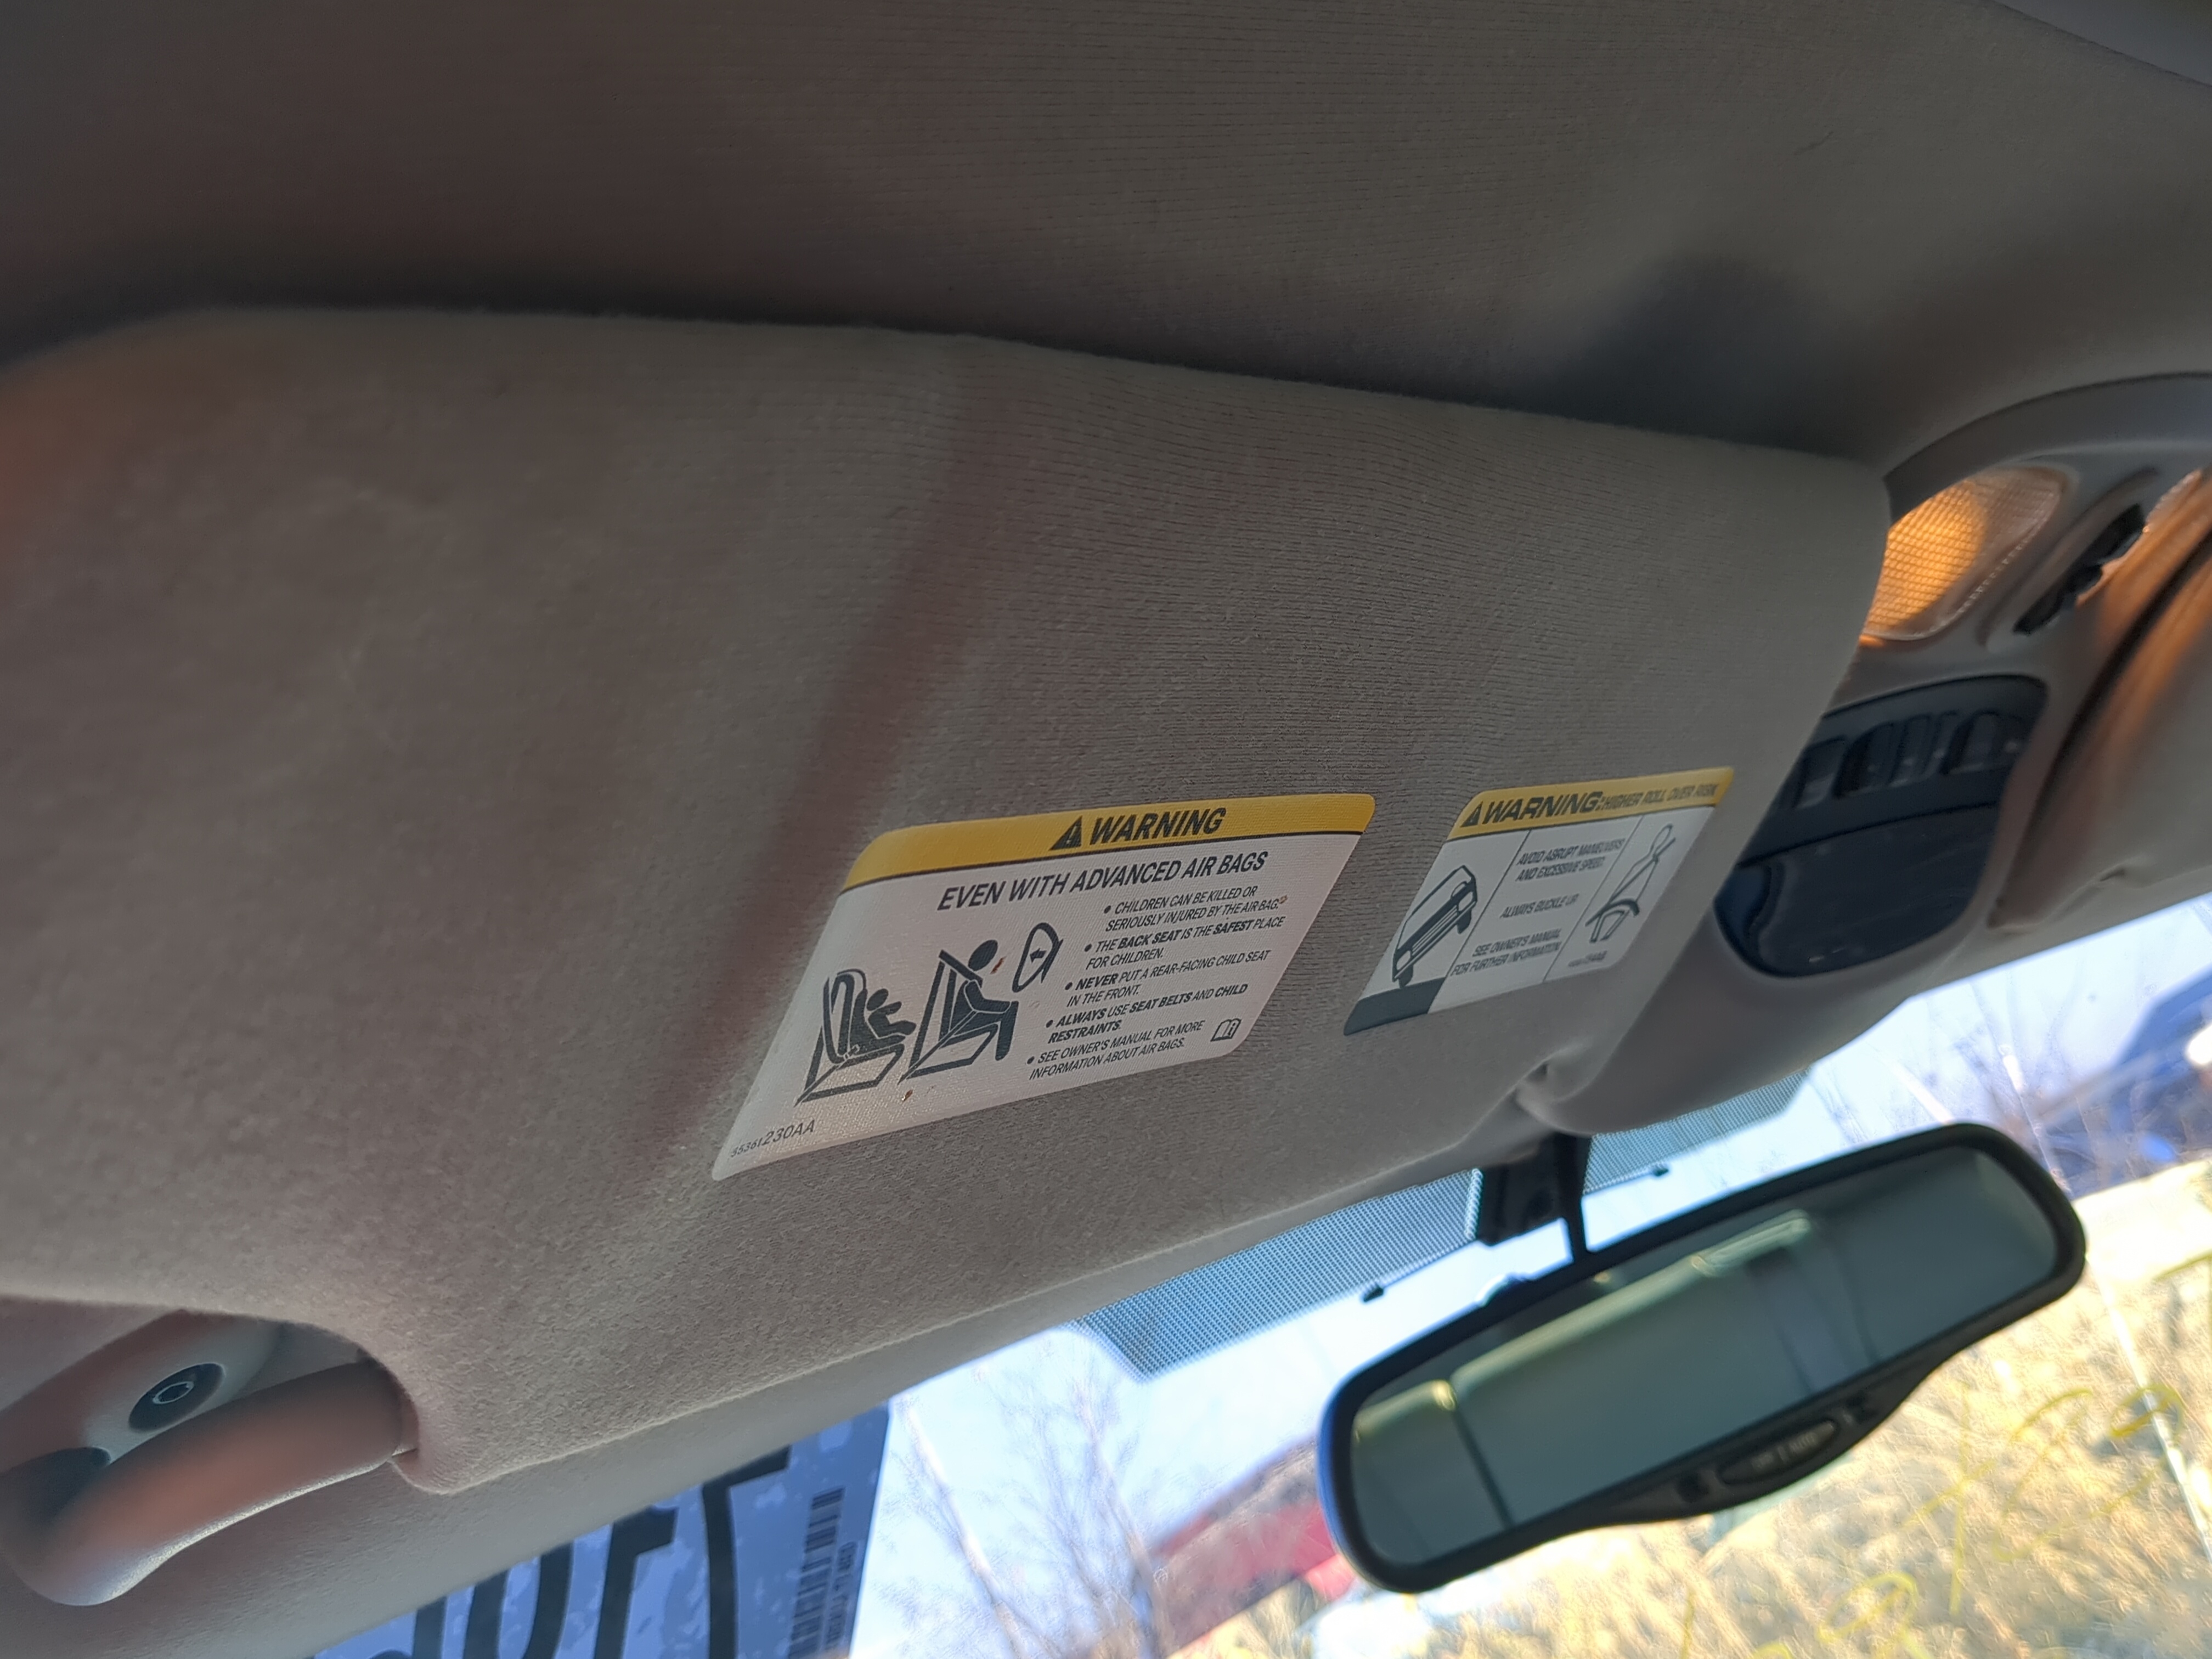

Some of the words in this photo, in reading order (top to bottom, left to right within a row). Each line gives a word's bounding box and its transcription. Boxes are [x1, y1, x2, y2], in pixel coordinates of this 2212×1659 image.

[1482, 791, 1603, 825] WARNING:
[1602, 792, 1644, 810] HIGHER
[1090, 808, 1226, 845] WARNING
[1516, 851, 1545, 865] AVOID
[1543, 845, 1579, 862] ABRUPT
[936, 882, 1006, 911] EVEN
[1008, 873, 1070, 901] WITH
[1070, 860, 1182, 893] ADVANCED
[1181, 856, 1216, 878] AIR
[1216, 850, 1268, 874] BAGS
[1515, 870, 1536, 882] AND
[1105, 912, 1165, 932] SERIOUSLY
[1164, 907, 1207, 924] INJURED
[1207, 906, 1221, 917] BY
[1221, 903, 1242, 915] THE
[1240, 901, 1260, 913] AIR
[1259, 899, 1279, 911] BAG.
[1114, 895, 1170, 915] CHILDREN
[1170, 893, 1191, 907] CAN
[1193, 891, 1207, 904] BE
[1206, 888, 1242, 902] KILLED
[1242, 885, 1258, 898] OR
[1499, 902, 1535, 918] ALWAYS
[1534, 896, 1565, 912] BUCKLE
[1096, 939, 1119, 953] THE
[1118, 934, 1154, 949] BACK
[1152, 929, 1181, 944] SEAT
[1181, 927, 1192, 940] IS
[1193, 925, 1213, 938] THE
[1213, 920, 1254, 934] SAFEST
[1252, 916, 1286, 929] PLACE
[1472, 943, 1492, 957] SEE
[1075, 974, 1119, 990] NEVER
[1118, 971, 1142, 983] PUT
[1141, 969, 1149, 979] A
[1150, 957, 1216, 978] REAR-FACING
[1216, 953, 1245, 966] CHILD
[1245, 950, 1271, 962] SEAT
[1086, 957, 1109, 970] FOR
[1110, 948, 1165, 966] CHILDREN.
[1451, 962, 1471, 976] FOR
[1470, 953, 1510, 972] FURTHER
[1056, 1008, 1107, 1028] ALWAYS
[1107, 1004, 1130, 1018] USE
[1128, 998, 1159, 1014] SEAT
[1158, 992, 1193, 1007] BELTS
[1192, 989, 1214, 1001] AND
[1214, 984, 1248, 997] CHILD
[1066, 995, 1083, 1007] IN
[1082, 991, 1104, 1003] THE
[1103, 984, 1141, 1001] FRONT.
[1037, 1051, 1062, 1064] SEE
[1060, 1041, 1109, 1059] OWNER'S
[1109, 1030, 1153, 1048] MANUAL
[1154, 1026, 1176, 1039] FOR
[1175, 1020, 1206, 1034] MORE
[1029, 1055, 1104, 1080] INFORMATION
[1103, 1046, 1140, 1064] ABOUT
[1138, 1043, 1157, 1056] AIR
